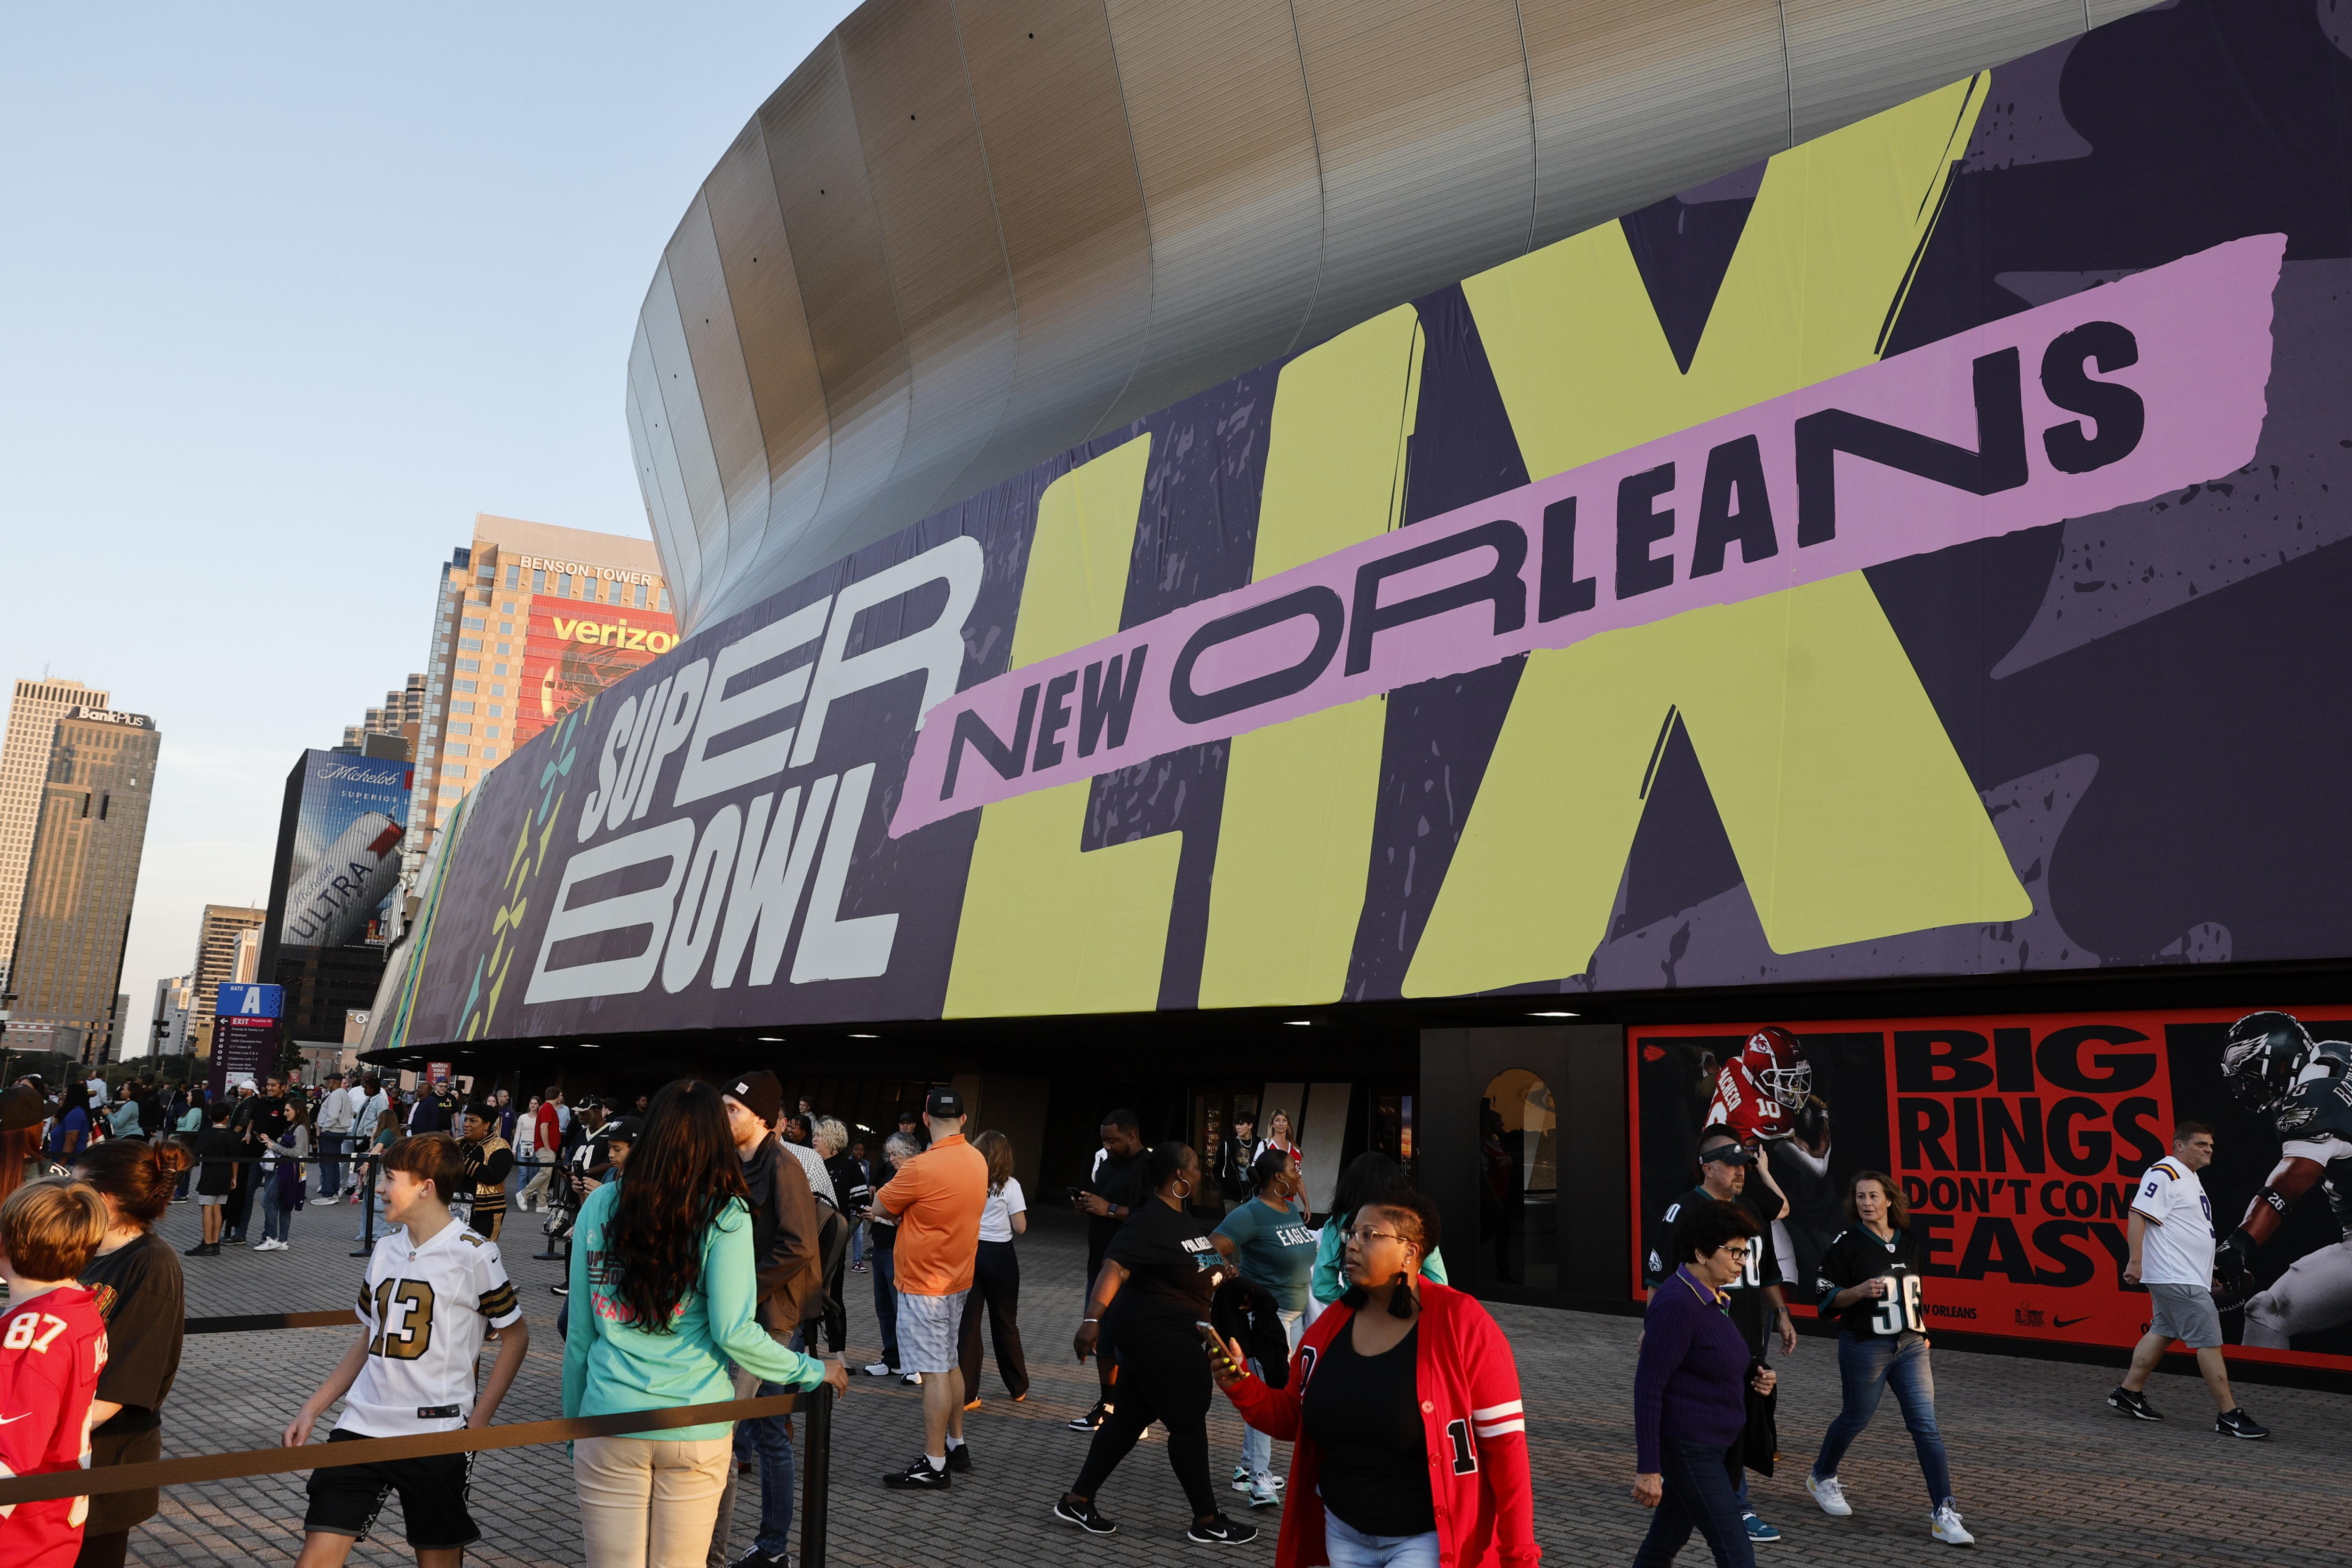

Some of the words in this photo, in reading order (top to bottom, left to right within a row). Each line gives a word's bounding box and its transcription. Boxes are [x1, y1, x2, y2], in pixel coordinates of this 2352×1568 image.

[939, 644, 1148, 801] NEW
[1169, 320, 2145, 724] ORLEANS
[941, 67, 2034, 1020] LIX
[520, 555, 589, 577] BENSON
[593, 566, 652, 587] TOWER
[577, 535, 984, 843] SUPER
[79, 706, 144, 726] BankPlus
[318, 763, 400, 785] Michelob
[342, 790, 398, 803] SUPERIOR
[290, 862, 373, 939] ULTRA
[524, 762, 899, 1004] BOWL
[240, 987, 260, 1014] A
[1893, 1025, 2157, 1094] BIG
[1718, 1066, 1741, 1112] PACHECO
[1756, 1098, 1781, 1119] 10
[1898, 1096, 2167, 1178] RINGS
[1901, 1175, 2032, 1215] DON'T
[2040, 1180, 2141, 1220] COM
[2144, 1181, 2159, 1198] 9
[2267, 1192, 2286, 1211] 26
[1192, 1253, 1225, 1273] EAGLE
[369, 1278, 435, 1360] 13
[1872, 1274, 1926, 1335] 36
[1932, 1304, 1977, 1320] ORLEANS
[3, 1312, 68, 1354] 87
